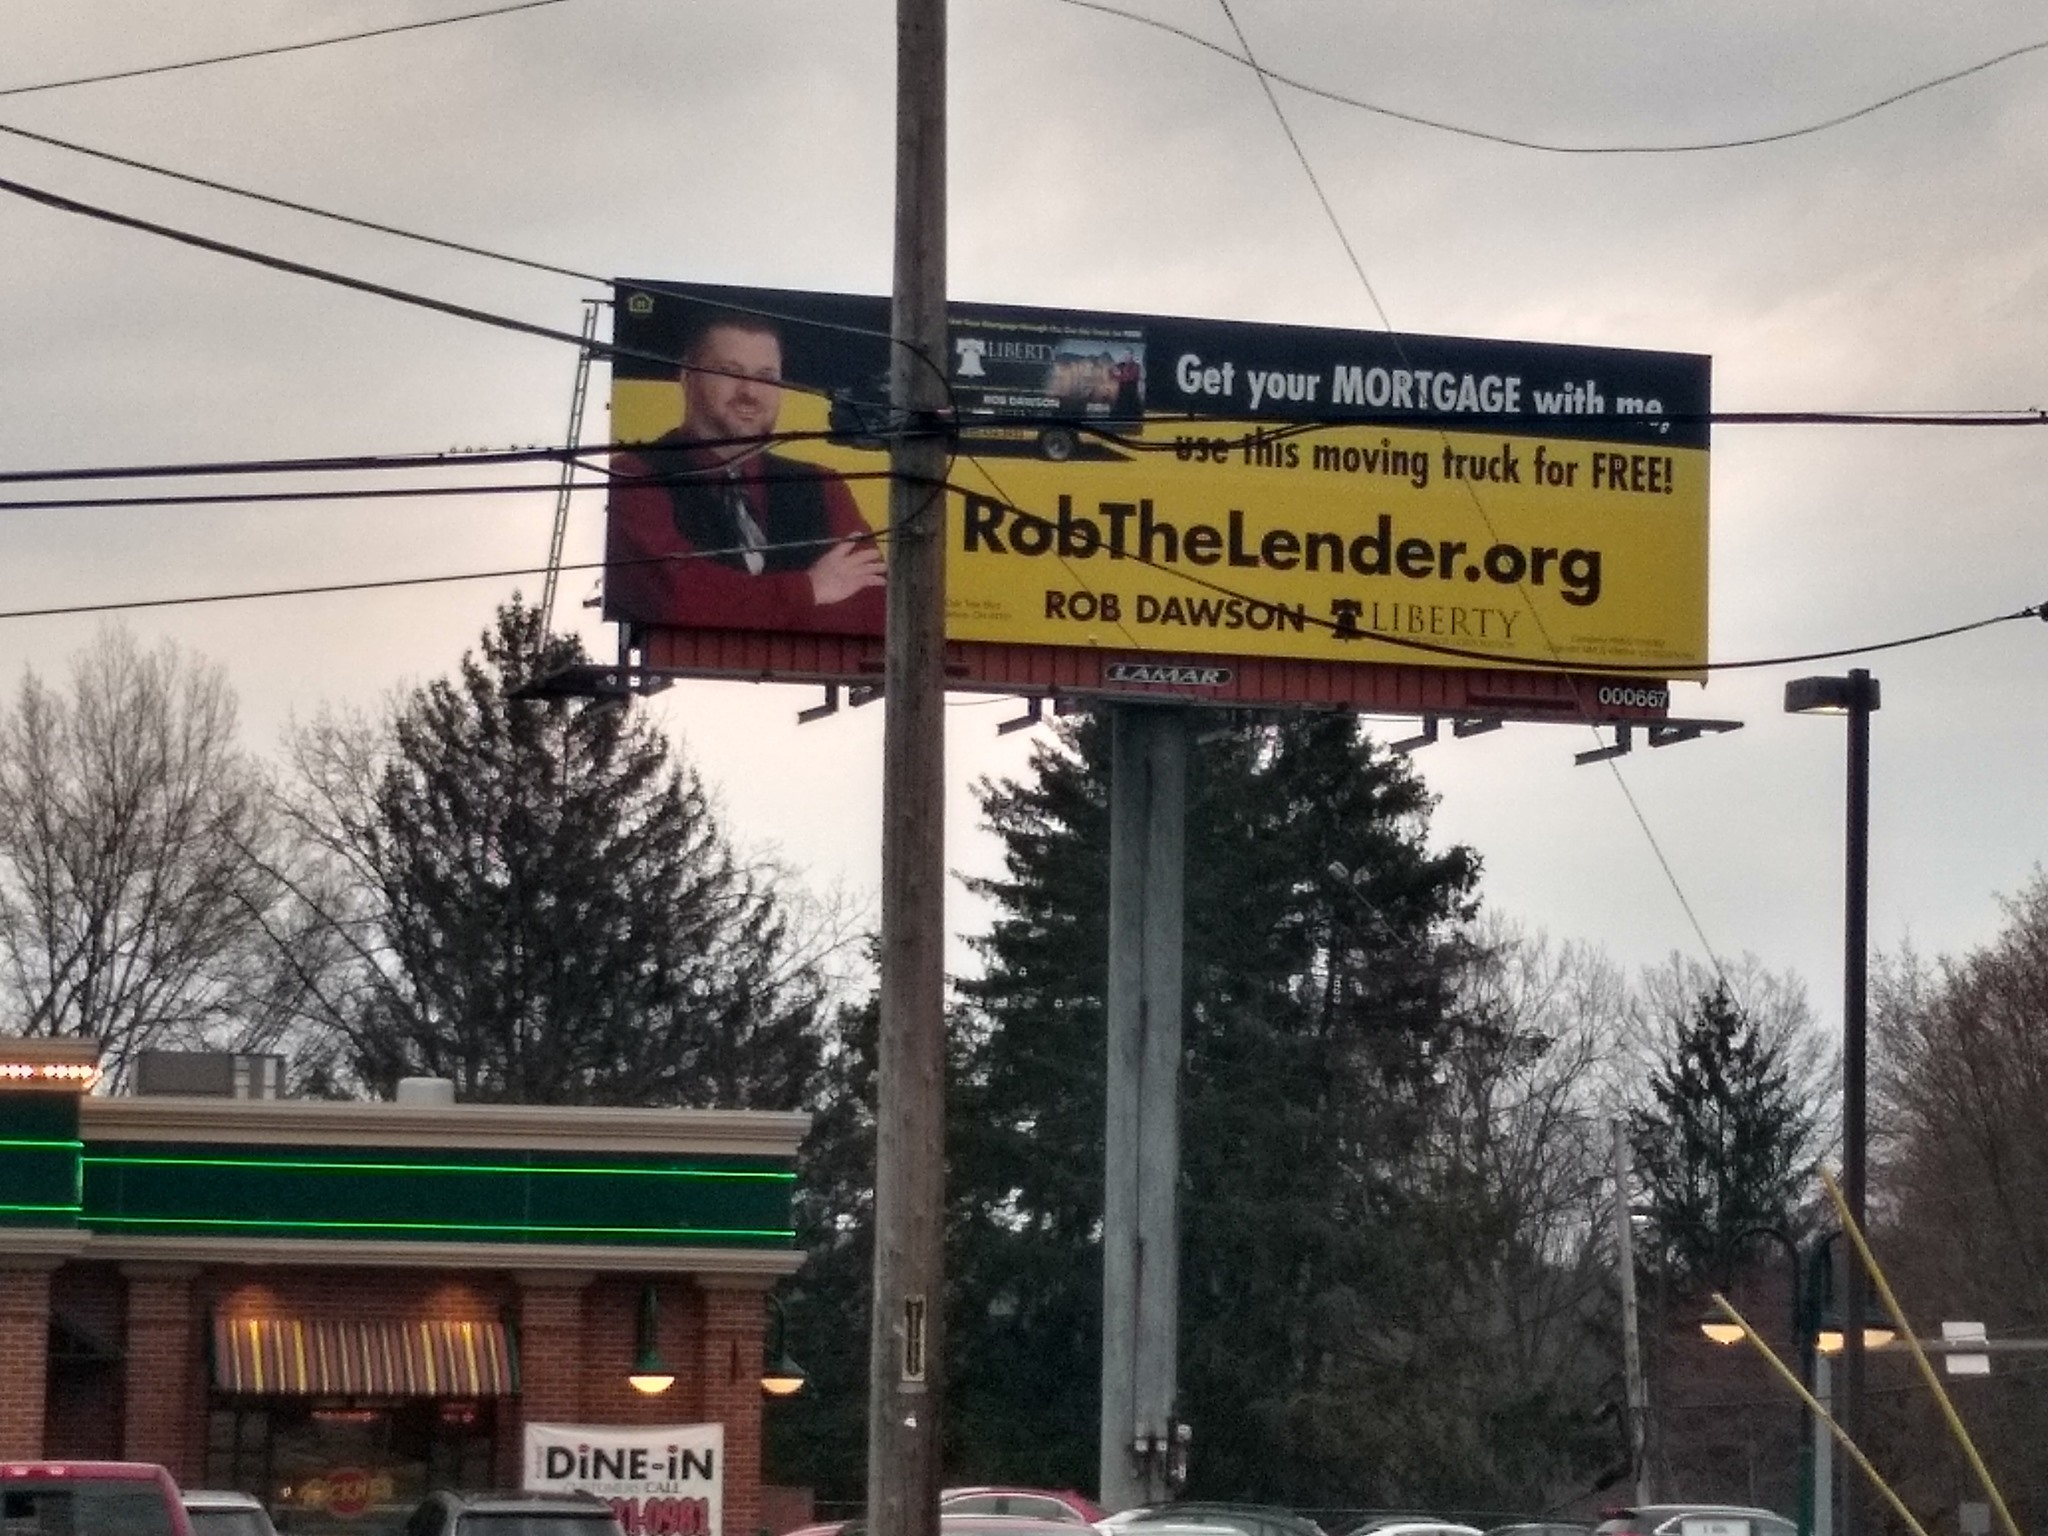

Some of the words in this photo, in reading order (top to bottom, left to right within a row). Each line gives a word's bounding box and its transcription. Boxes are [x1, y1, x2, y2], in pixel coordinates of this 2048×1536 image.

[1176, 354, 1235, 396] Get
[1247, 370, 1320, 410] your
[1332, 364, 1521, 413] MORTGAGE
[1533, 380, 1605, 414] with
[1175, 436, 1229, 464] use
[1244, 426, 1300, 469] this
[1313, 438, 1429, 488] moving
[1442, 444, 1520, 484] truck
[1533, 445, 1579, 487] for
[1592, 453, 1673, 494] FREE!
[963, 495, 1602, 606] RobTheLender.org
[1045, 590, 1121, 622] ROB
[1136, 594, 1304, 633] DAWSON
[1372, 602, 1520, 639] LIBERTY
[1113, 664, 1220, 684] LAMAR
[1598, 686, 1668, 709] 000667
